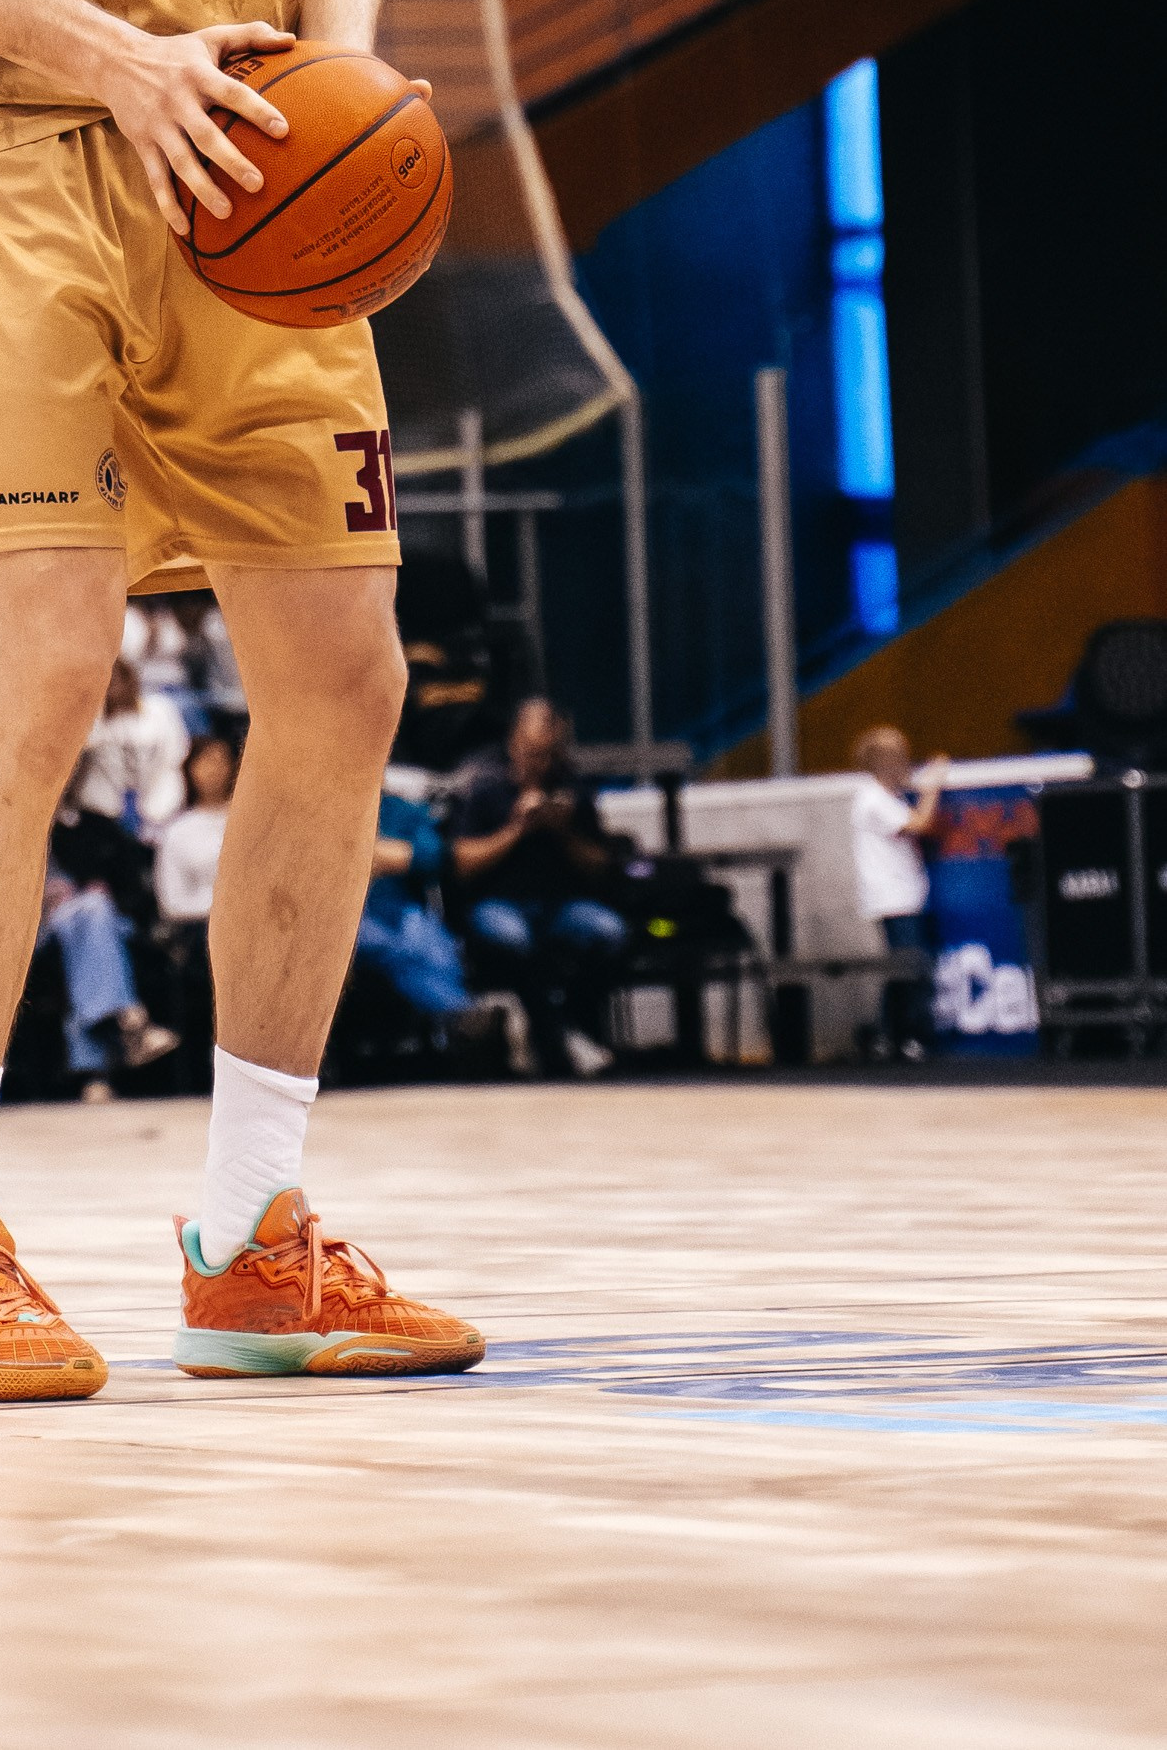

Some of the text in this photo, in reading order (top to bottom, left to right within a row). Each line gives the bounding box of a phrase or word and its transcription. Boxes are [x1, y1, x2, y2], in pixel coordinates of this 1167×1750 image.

[398, 147, 421, 180] РФБ
[338, 175, 385, 216] БАСКЕТБОЛА
[340, 195, 399, 246] ОФИЦИАЛЬНЫЙ
[292, 185, 392, 260] РОССИЙСКОЙ ФЕДЕРАЦИИ
[333, 429, 397, 533] 31
